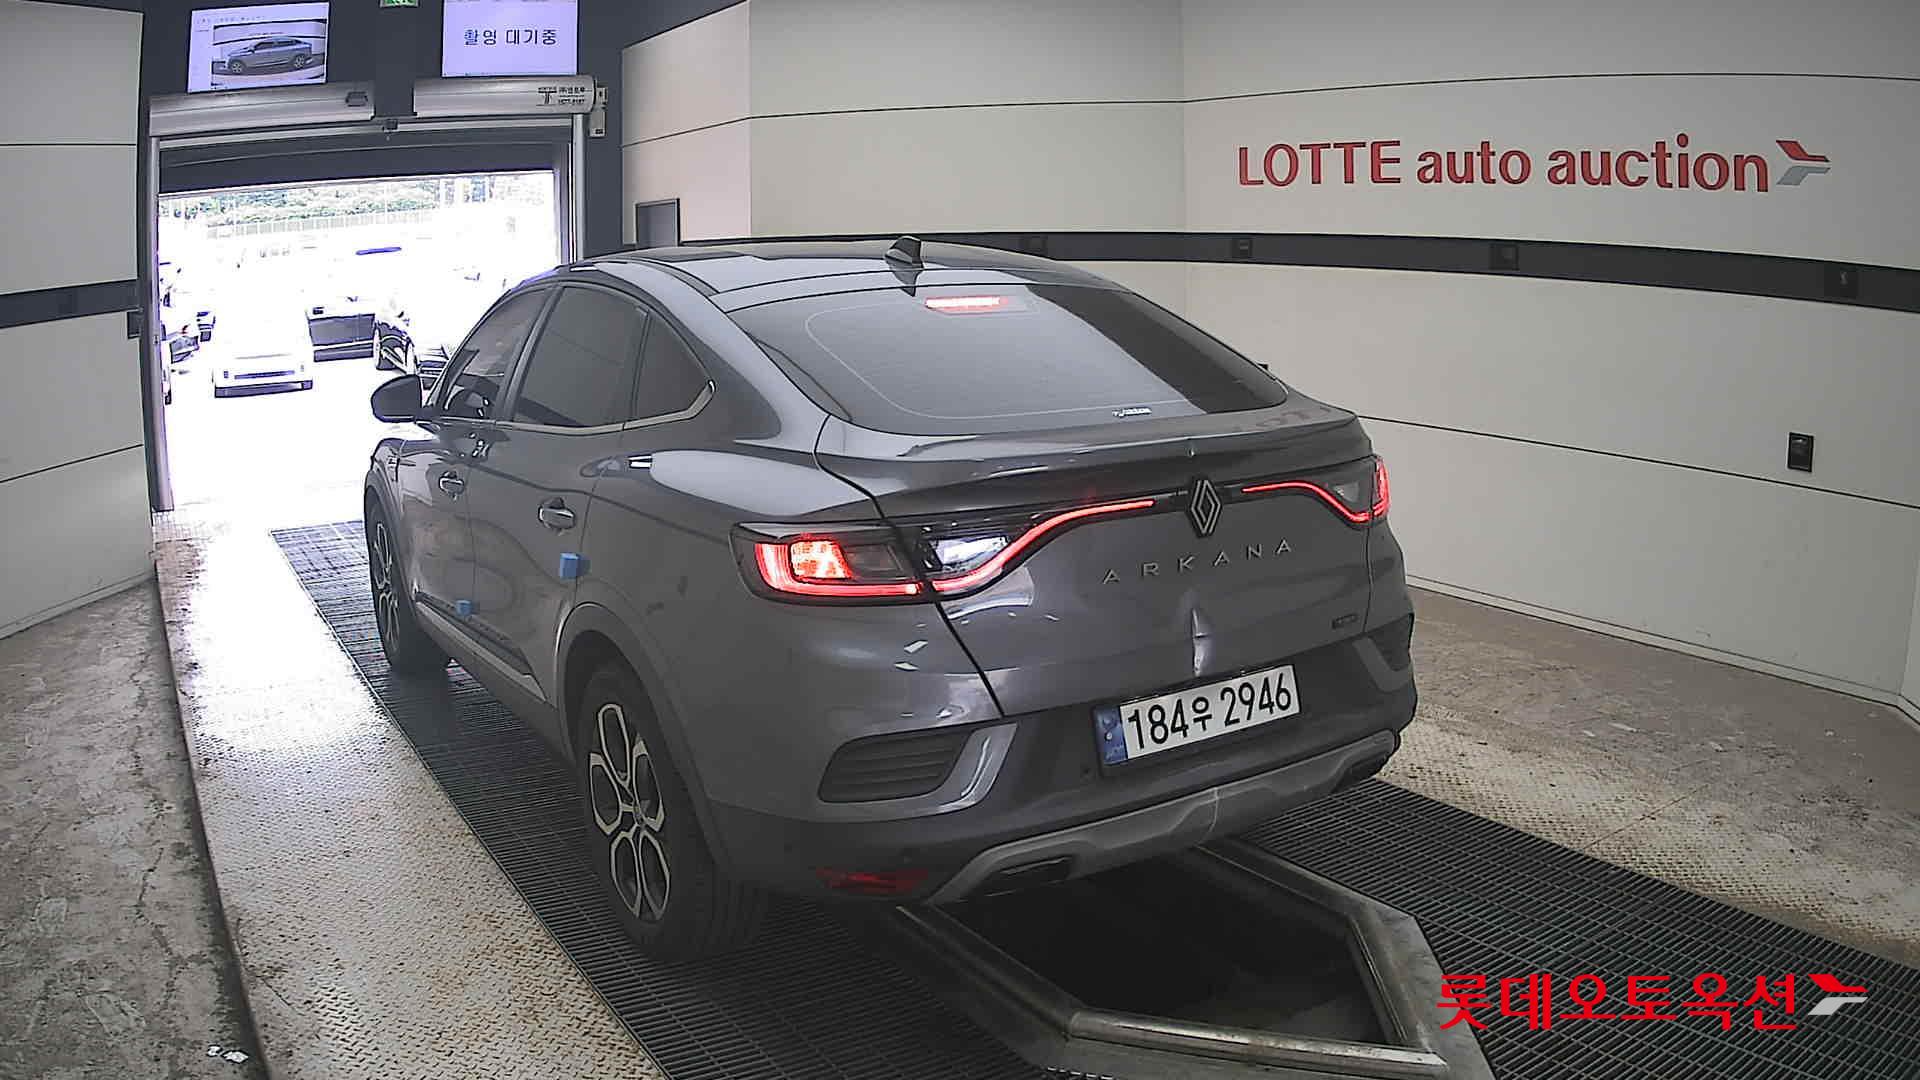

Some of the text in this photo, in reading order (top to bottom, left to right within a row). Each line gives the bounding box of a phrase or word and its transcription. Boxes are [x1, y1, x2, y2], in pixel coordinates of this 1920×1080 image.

[506, 29, 557, 46] 대기중
[1238, 132, 1769, 193] LOTTE auto auction
[1102, 539, 1292, 585] ARKANA
[1127, 673, 1292, 749] 184우 2946
